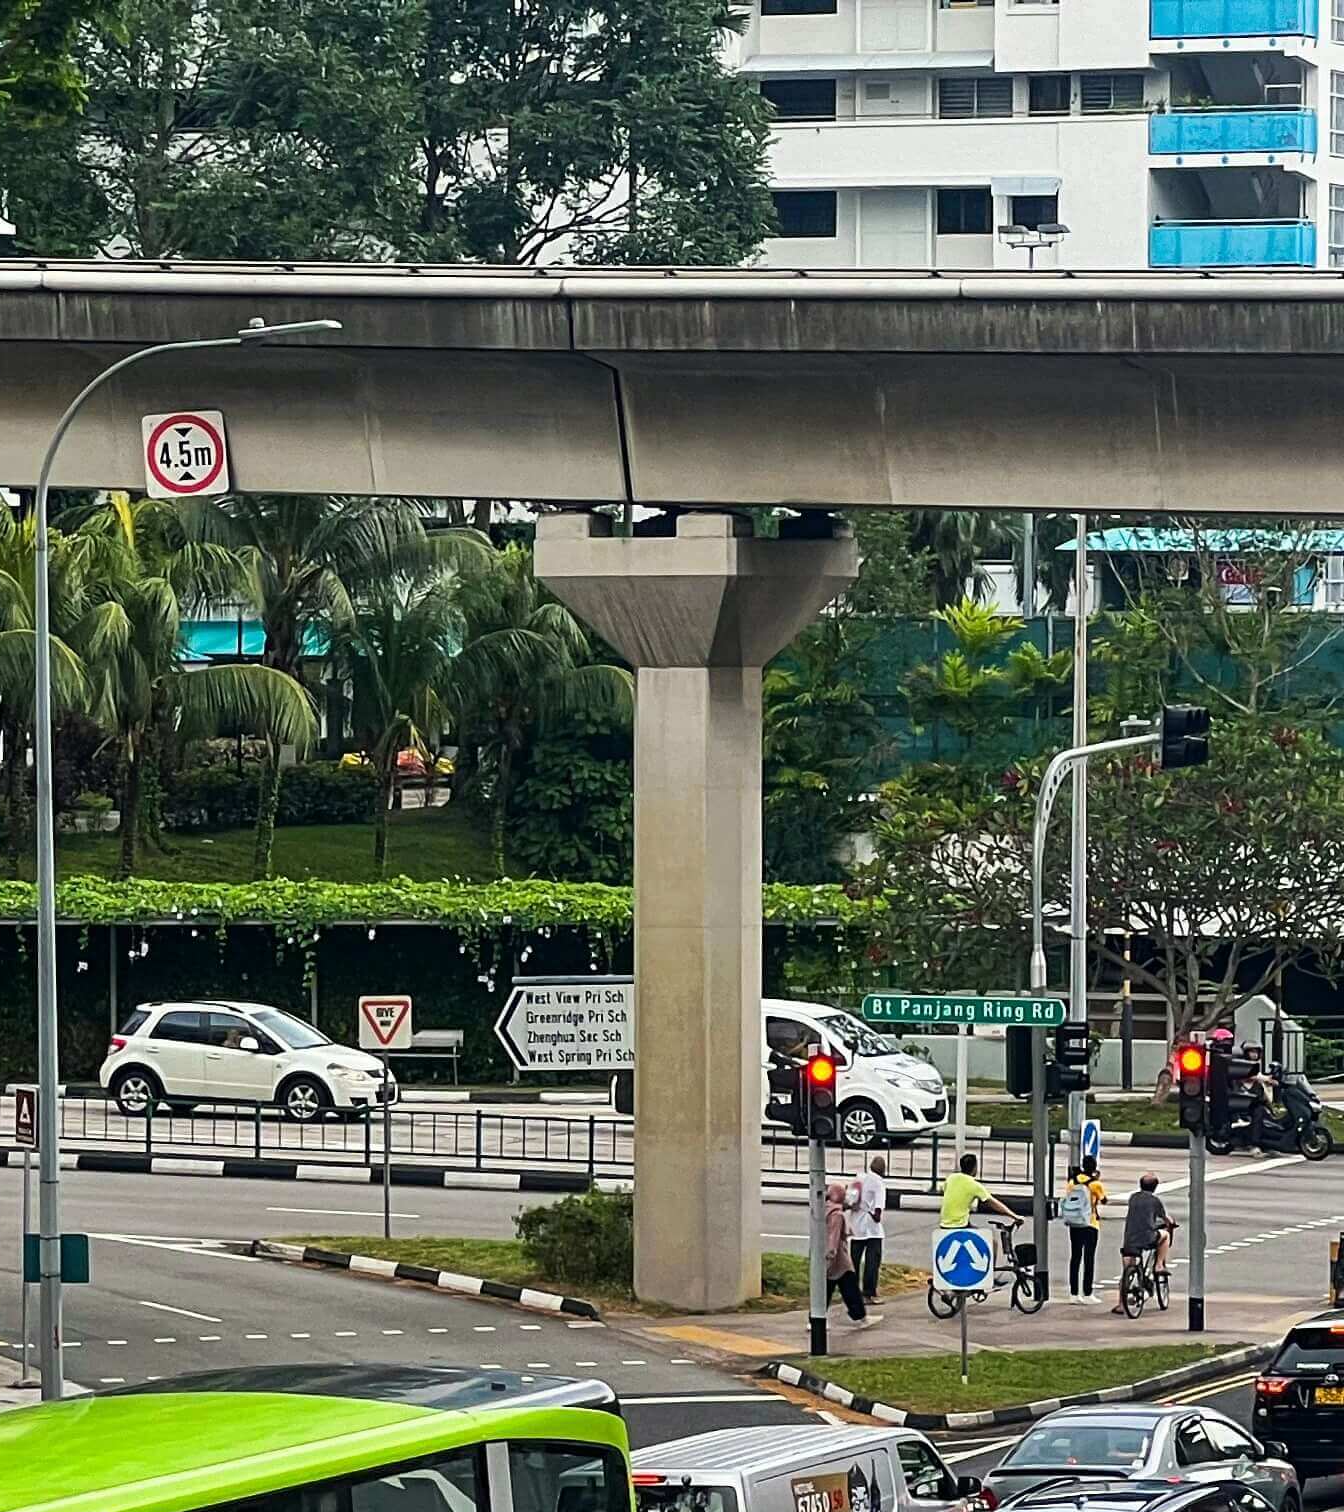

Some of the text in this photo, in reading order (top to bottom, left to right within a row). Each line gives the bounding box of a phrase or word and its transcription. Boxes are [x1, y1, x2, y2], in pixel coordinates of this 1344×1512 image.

[159, 440, 212, 468] 4.5m
[525, 990, 624, 1004] West View Pri Sch
[375, 1007, 395, 1018] GIVE
[525, 1010, 627, 1026] Greenridge Pri Sch
[872, 998, 1055, 1022] Bt Panjang Ring Rd
[527, 1029, 622, 1046] Zhenghua Sec Sch
[527, 1049, 634, 1065] West Spring Pri Sch
